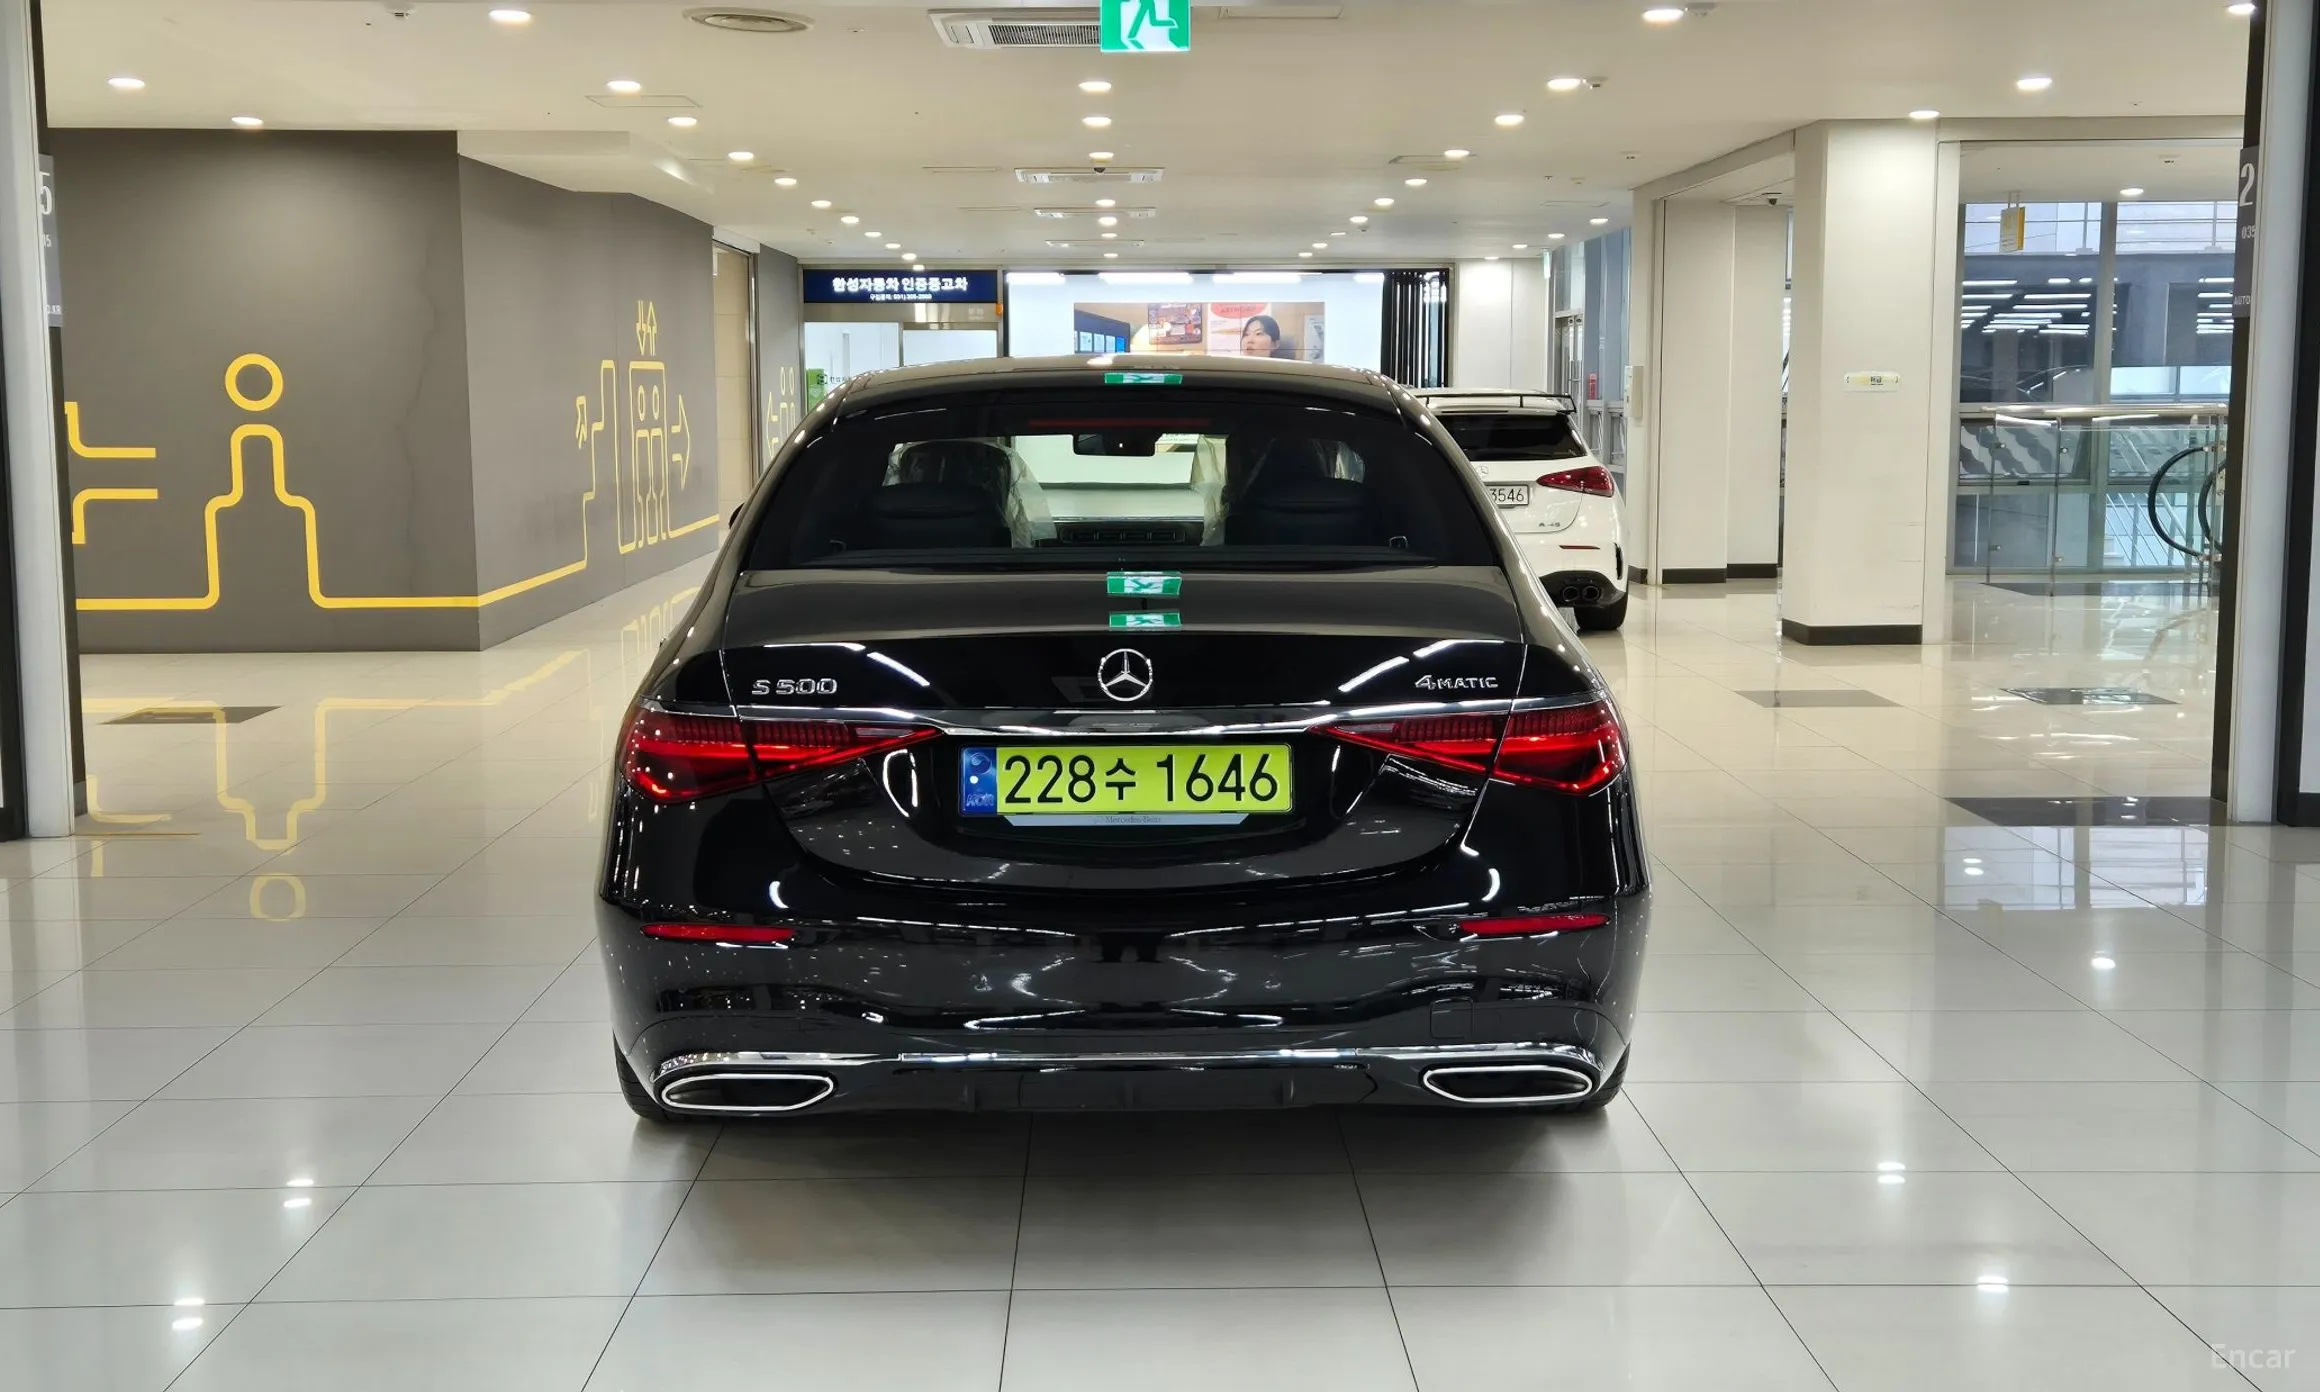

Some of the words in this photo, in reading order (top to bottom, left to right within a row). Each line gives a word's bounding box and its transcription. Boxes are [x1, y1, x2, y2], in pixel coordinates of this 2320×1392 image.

[2239, 163, 2255, 207] 2
[832, 276, 899, 292] 한성자동차
[901, 276, 968, 292] 인증중고차
[1490, 488, 1524, 502] 3546
[751, 679, 771, 695] S
[775, 678, 838, 695] 500
[1414, 674, 1499, 691] 4MATIC
[1004, 754, 1137, 804] 228수
[1156, 753, 1279, 802] 1646
